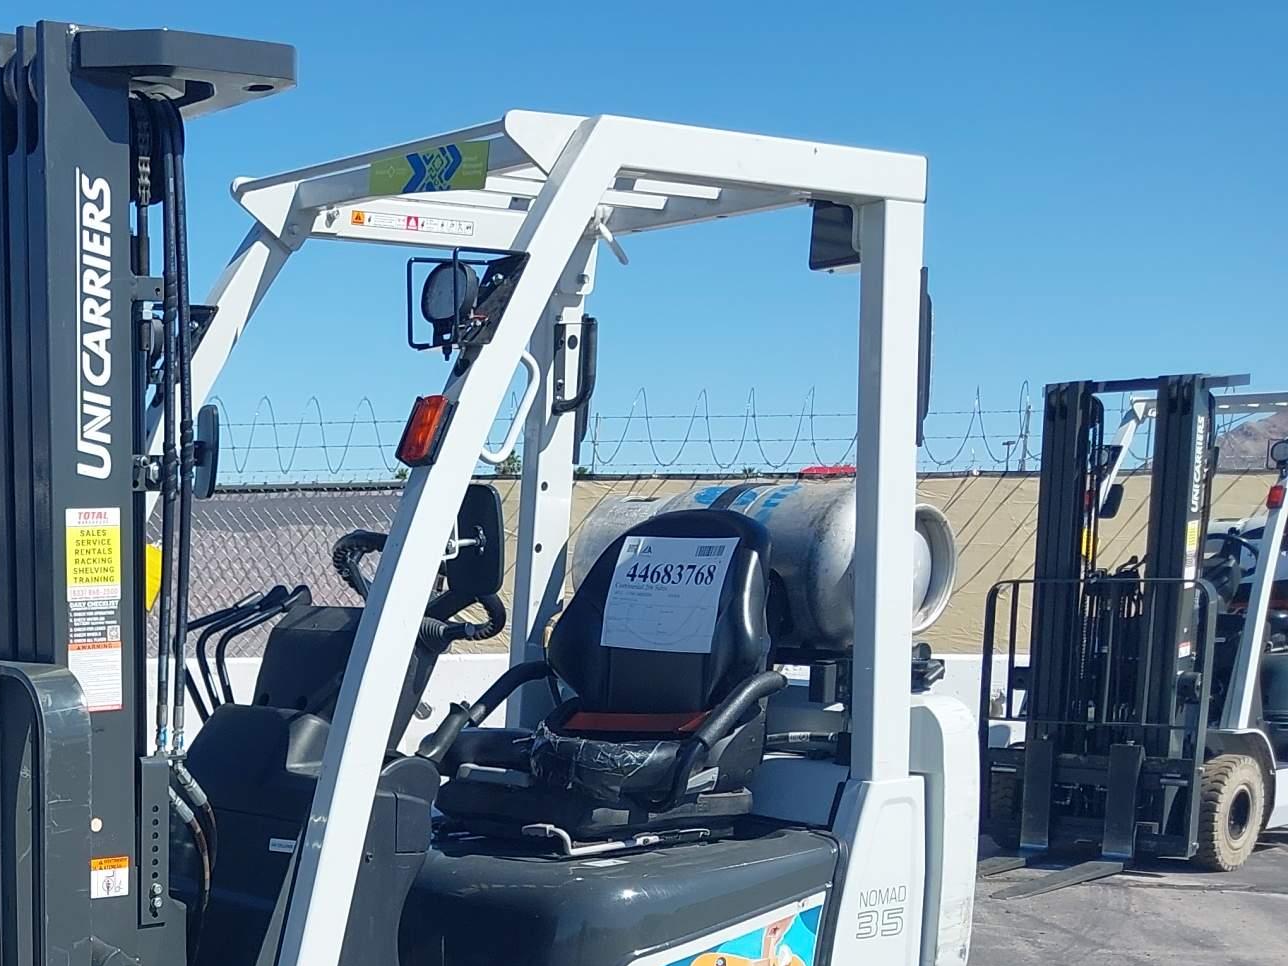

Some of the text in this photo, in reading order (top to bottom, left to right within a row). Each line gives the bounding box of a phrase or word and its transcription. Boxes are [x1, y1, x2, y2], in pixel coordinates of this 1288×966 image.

[77, 511, 108, 520] TOTAL
[80, 529, 107, 537] SALES
[75, 539, 112, 547] SERVICE
[74, 548, 113, 556] RENTALS
[74, 557, 113, 565] RACKING
[73, 567, 115, 575] SHELVING
[626, 562, 716, 585] 44683768
[73, 576, 115, 584] TRAINING
[859, 885, 907, 909] NOMAD
[855, 907, 905, 939] 35
